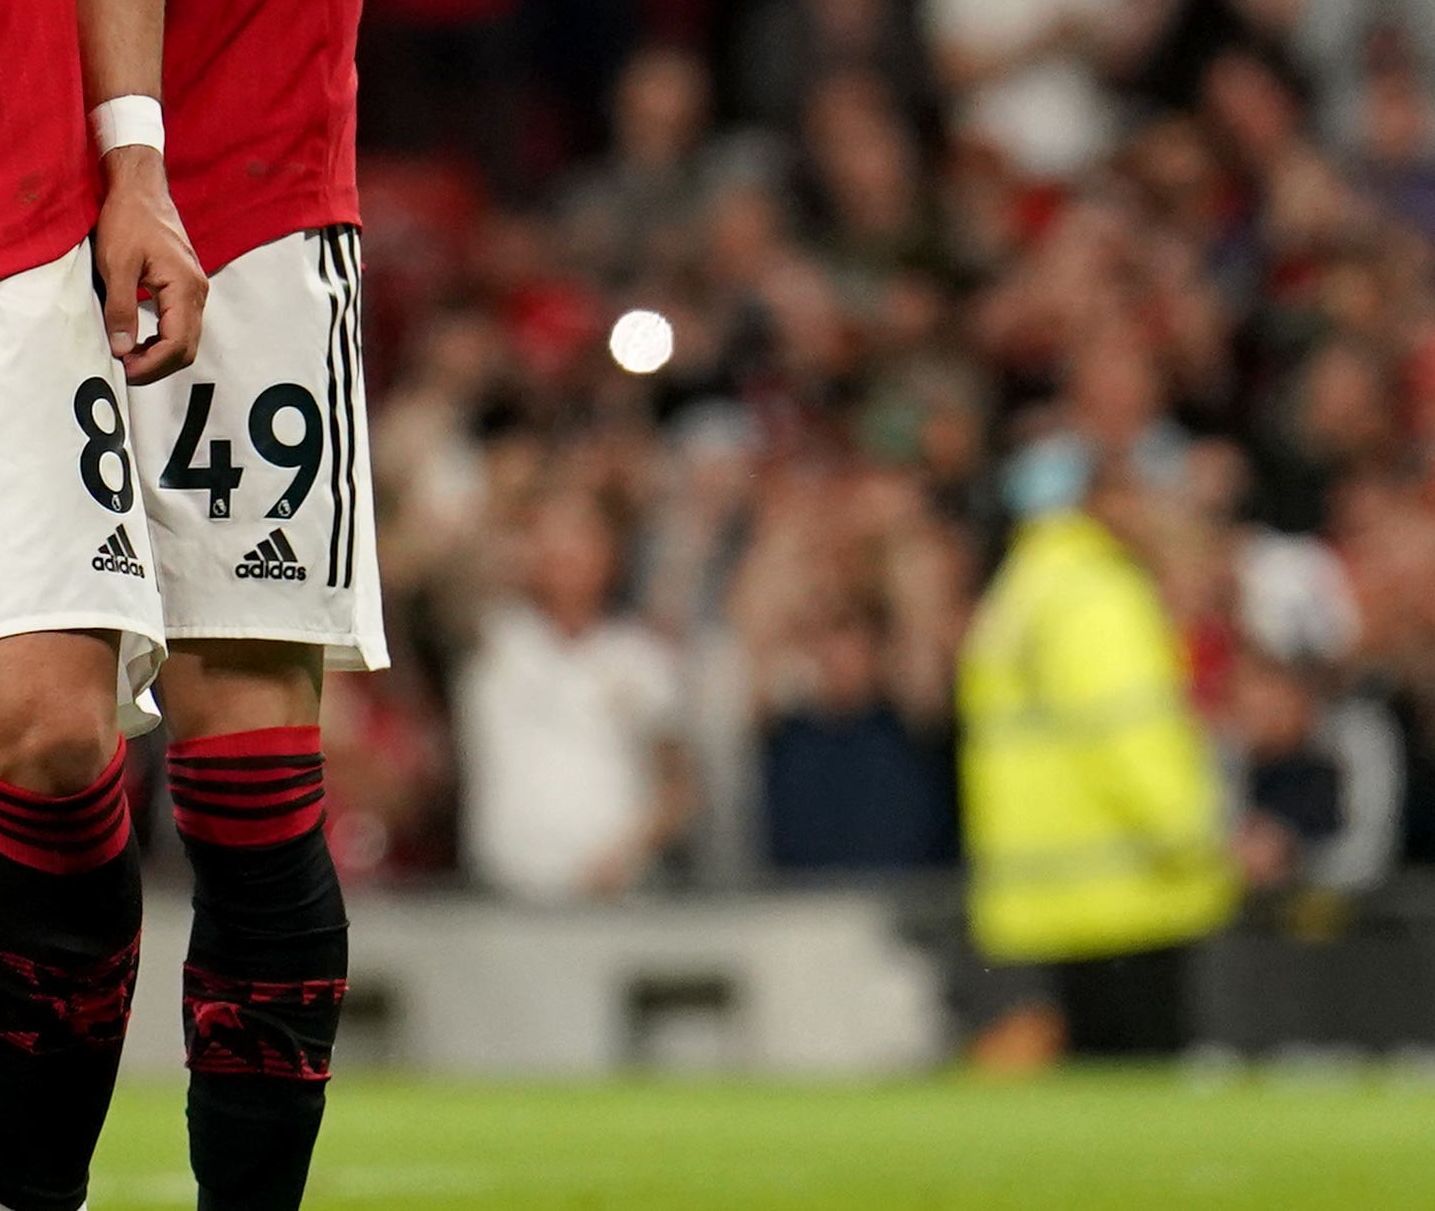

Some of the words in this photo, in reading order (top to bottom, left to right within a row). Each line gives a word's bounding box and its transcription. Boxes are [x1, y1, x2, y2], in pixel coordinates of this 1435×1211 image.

[73, 376, 135, 515] 8
[158, 382, 325, 520] 49
[91, 555, 146, 580] adidas
[235, 560, 307, 582] adidas
